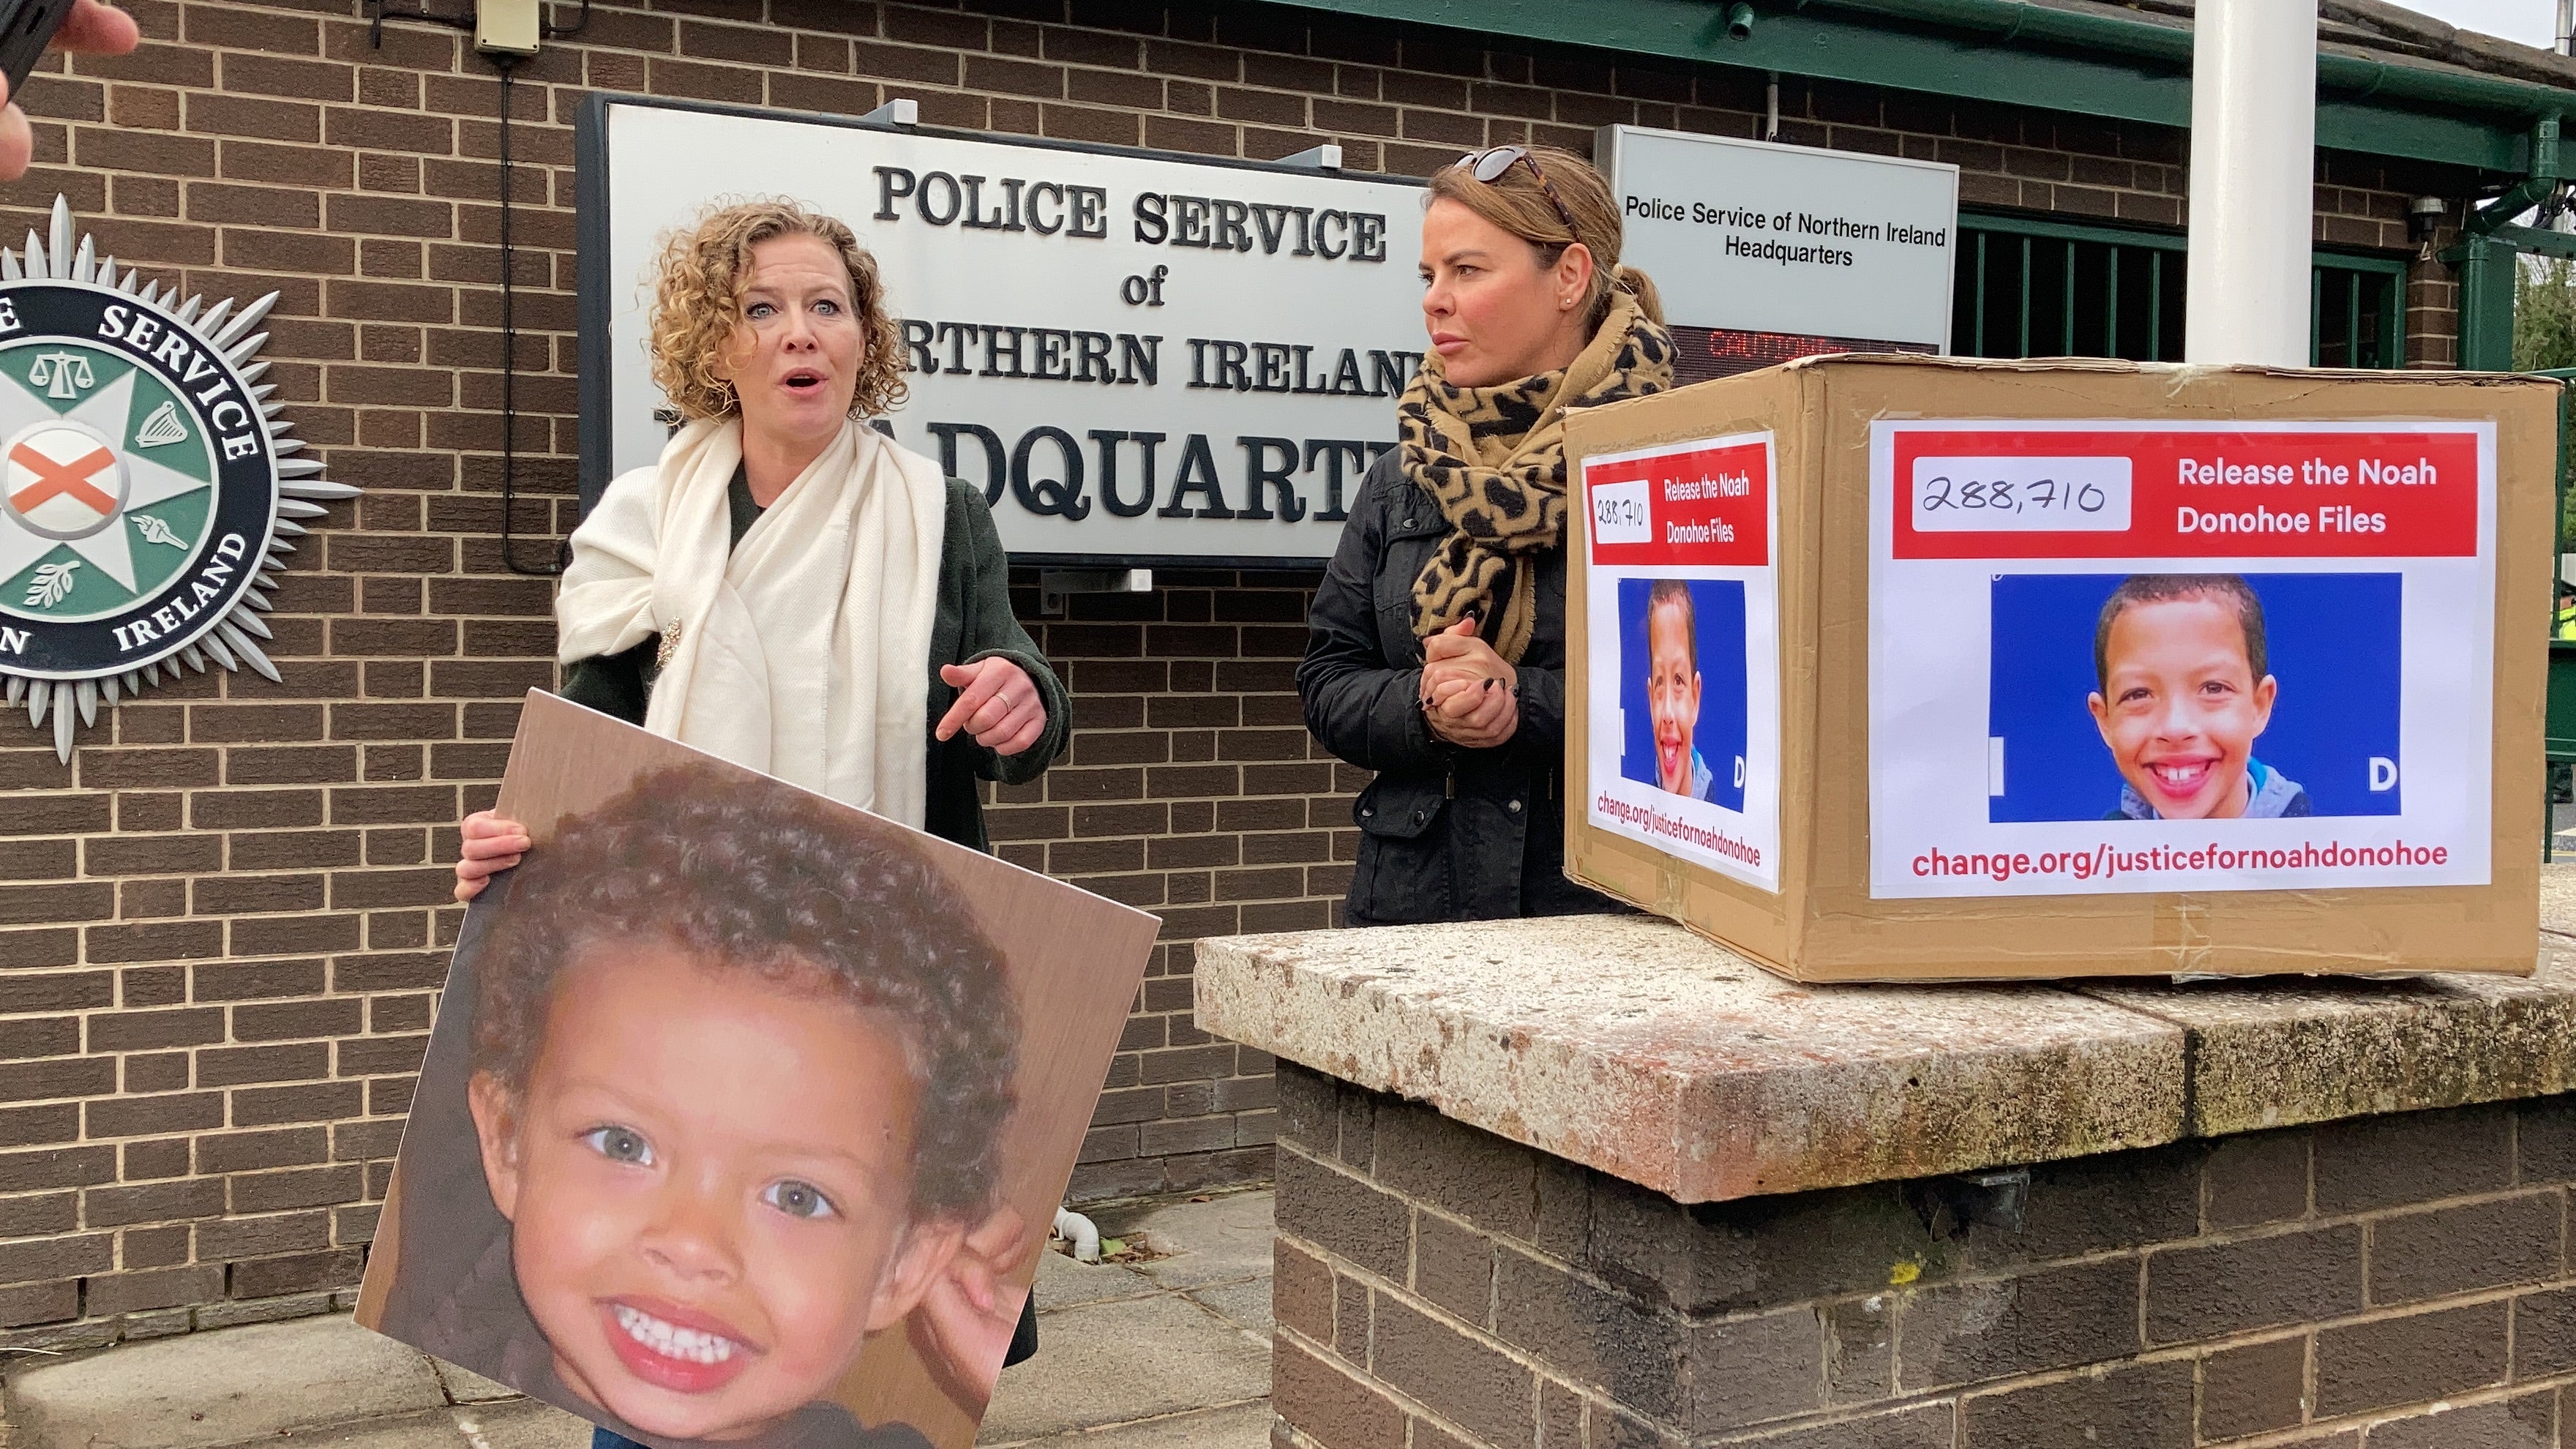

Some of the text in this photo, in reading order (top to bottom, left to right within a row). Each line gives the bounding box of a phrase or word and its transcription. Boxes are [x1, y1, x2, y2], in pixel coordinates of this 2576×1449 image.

[872, 165, 1388, 263] POLICE SERVICE
[1625, 195, 1947, 247] Police Service of Northern Ireland
[1725, 234, 1854, 266] Headquarters
[1120, 263, 1169, 306] of
[892, 318, 1424, 400] RTHERN IRELAN
[98, 304, 258, 460] SERVICE
[1663, 469, 1750, 502] Release the Noah
[2178, 457, 2438, 486] Release the Noah
[1598, 498, 1644, 528] 288,710
[1922, 475, 2105, 515] 288,710
[1666, 517, 1734, 544] Donohoe Files
[2177, 505, 2386, 535] Donohoe Files
[112, 533, 246, 652] IRELAND
[1598, 790, 1761, 867] change.org/justicefornoahdonohoe
[1912, 841, 2449, 882] change.org/justicefornoahdonohoe
